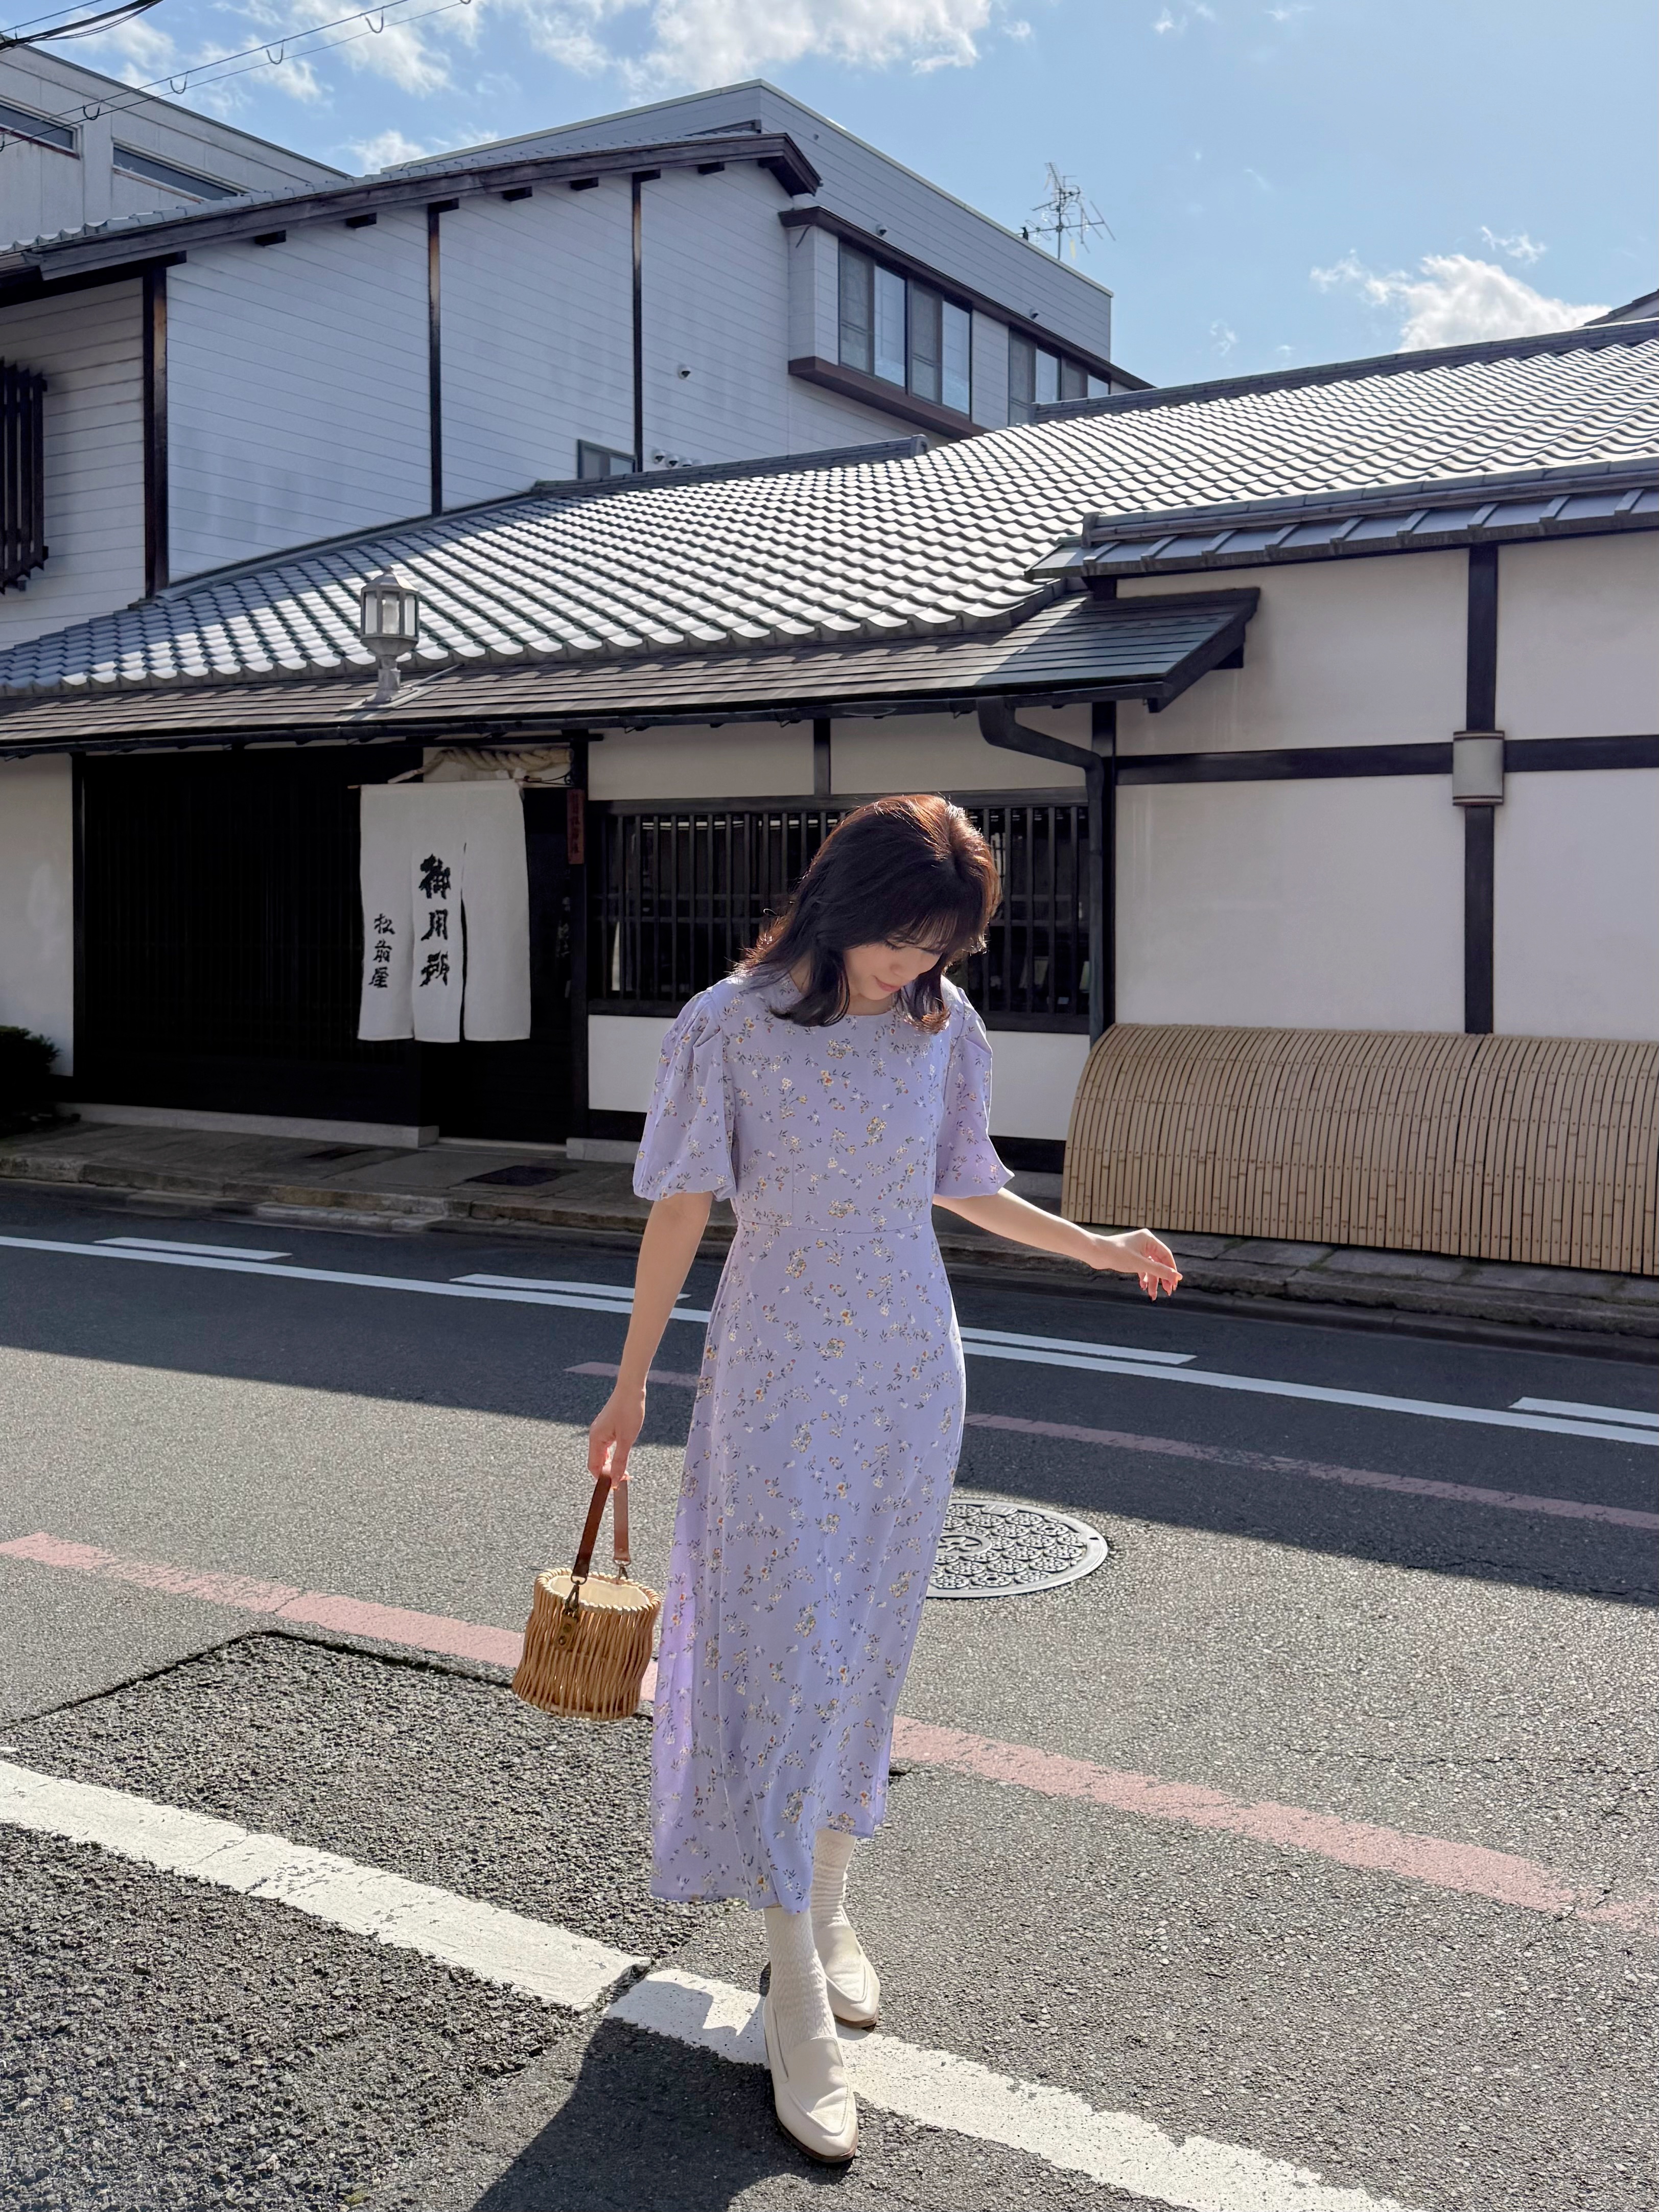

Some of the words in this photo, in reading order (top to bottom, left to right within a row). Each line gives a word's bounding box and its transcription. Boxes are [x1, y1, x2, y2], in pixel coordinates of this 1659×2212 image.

[368, 913, 395, 988] 松前屋
[418, 853, 451, 987] 御用所
